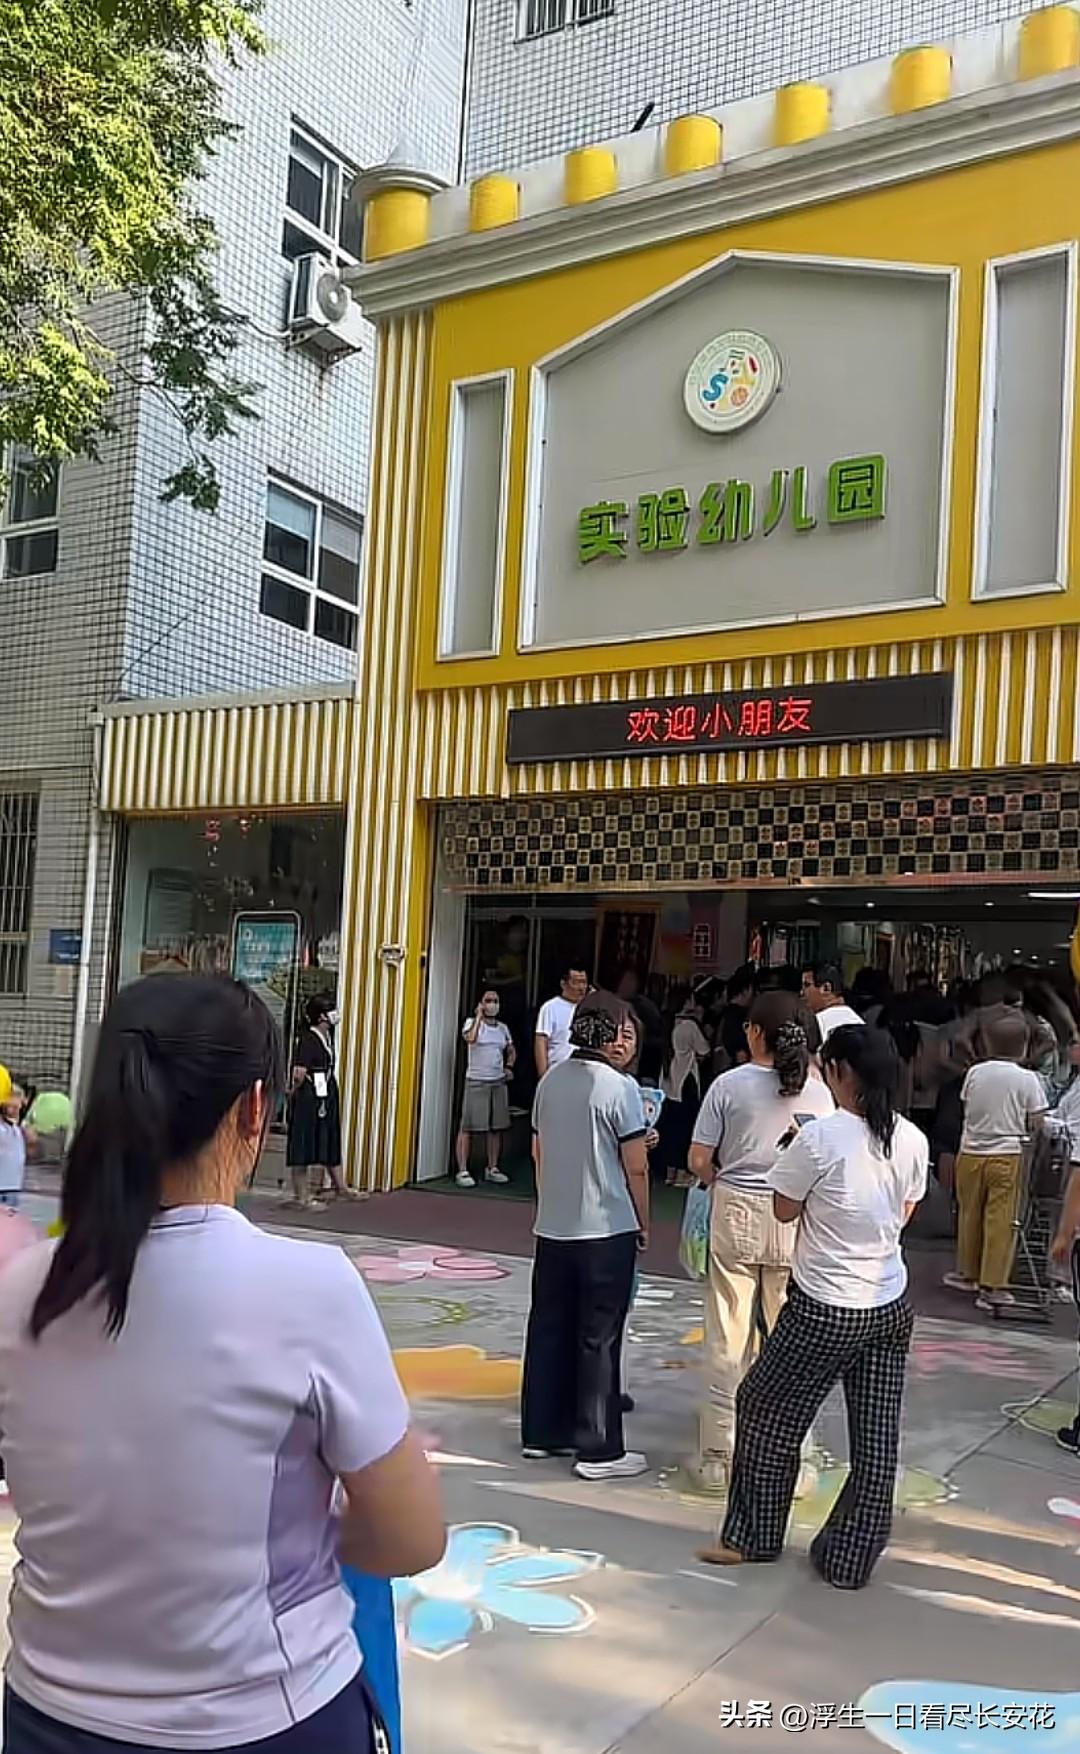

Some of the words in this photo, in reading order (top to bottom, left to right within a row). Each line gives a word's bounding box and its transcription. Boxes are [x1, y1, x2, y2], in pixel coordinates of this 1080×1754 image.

[578, 453, 886, 564] 实验幼儿园
[627, 696, 812, 742] 欢迎小朋友
